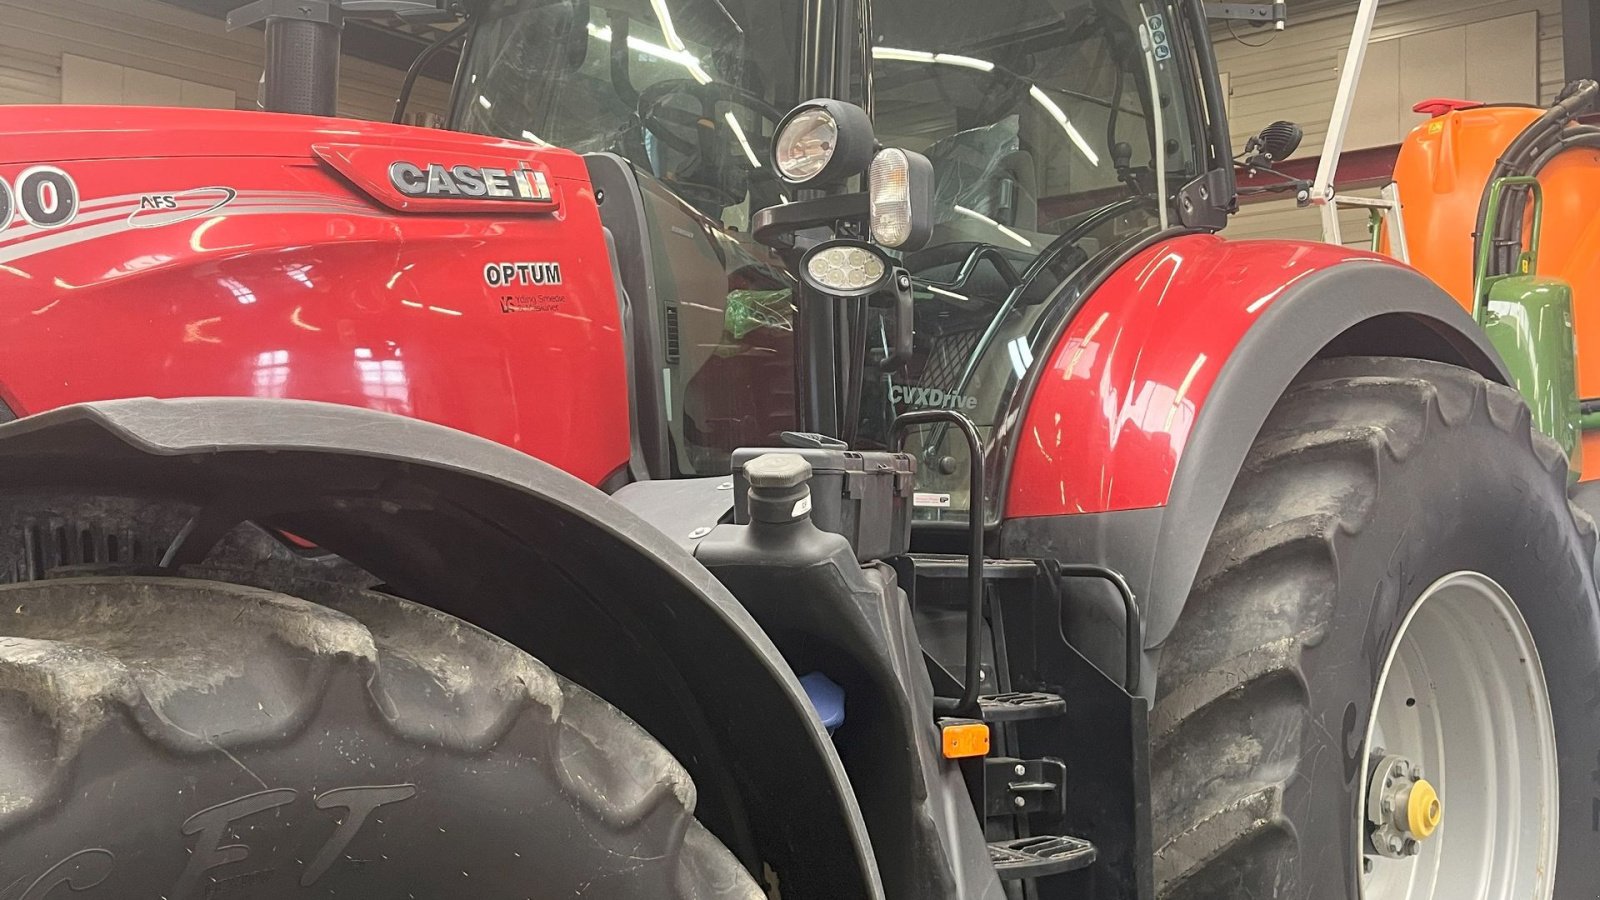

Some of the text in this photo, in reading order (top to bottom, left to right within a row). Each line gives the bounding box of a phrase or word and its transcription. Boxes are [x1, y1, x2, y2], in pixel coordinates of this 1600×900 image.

[389, 160, 513, 197] CASE
[0, 165, 79, 234] 0
[140, 195, 177, 209] AFS
[484, 262, 562, 287] OPTUM
[891, 385, 977, 410] CVXDrive
